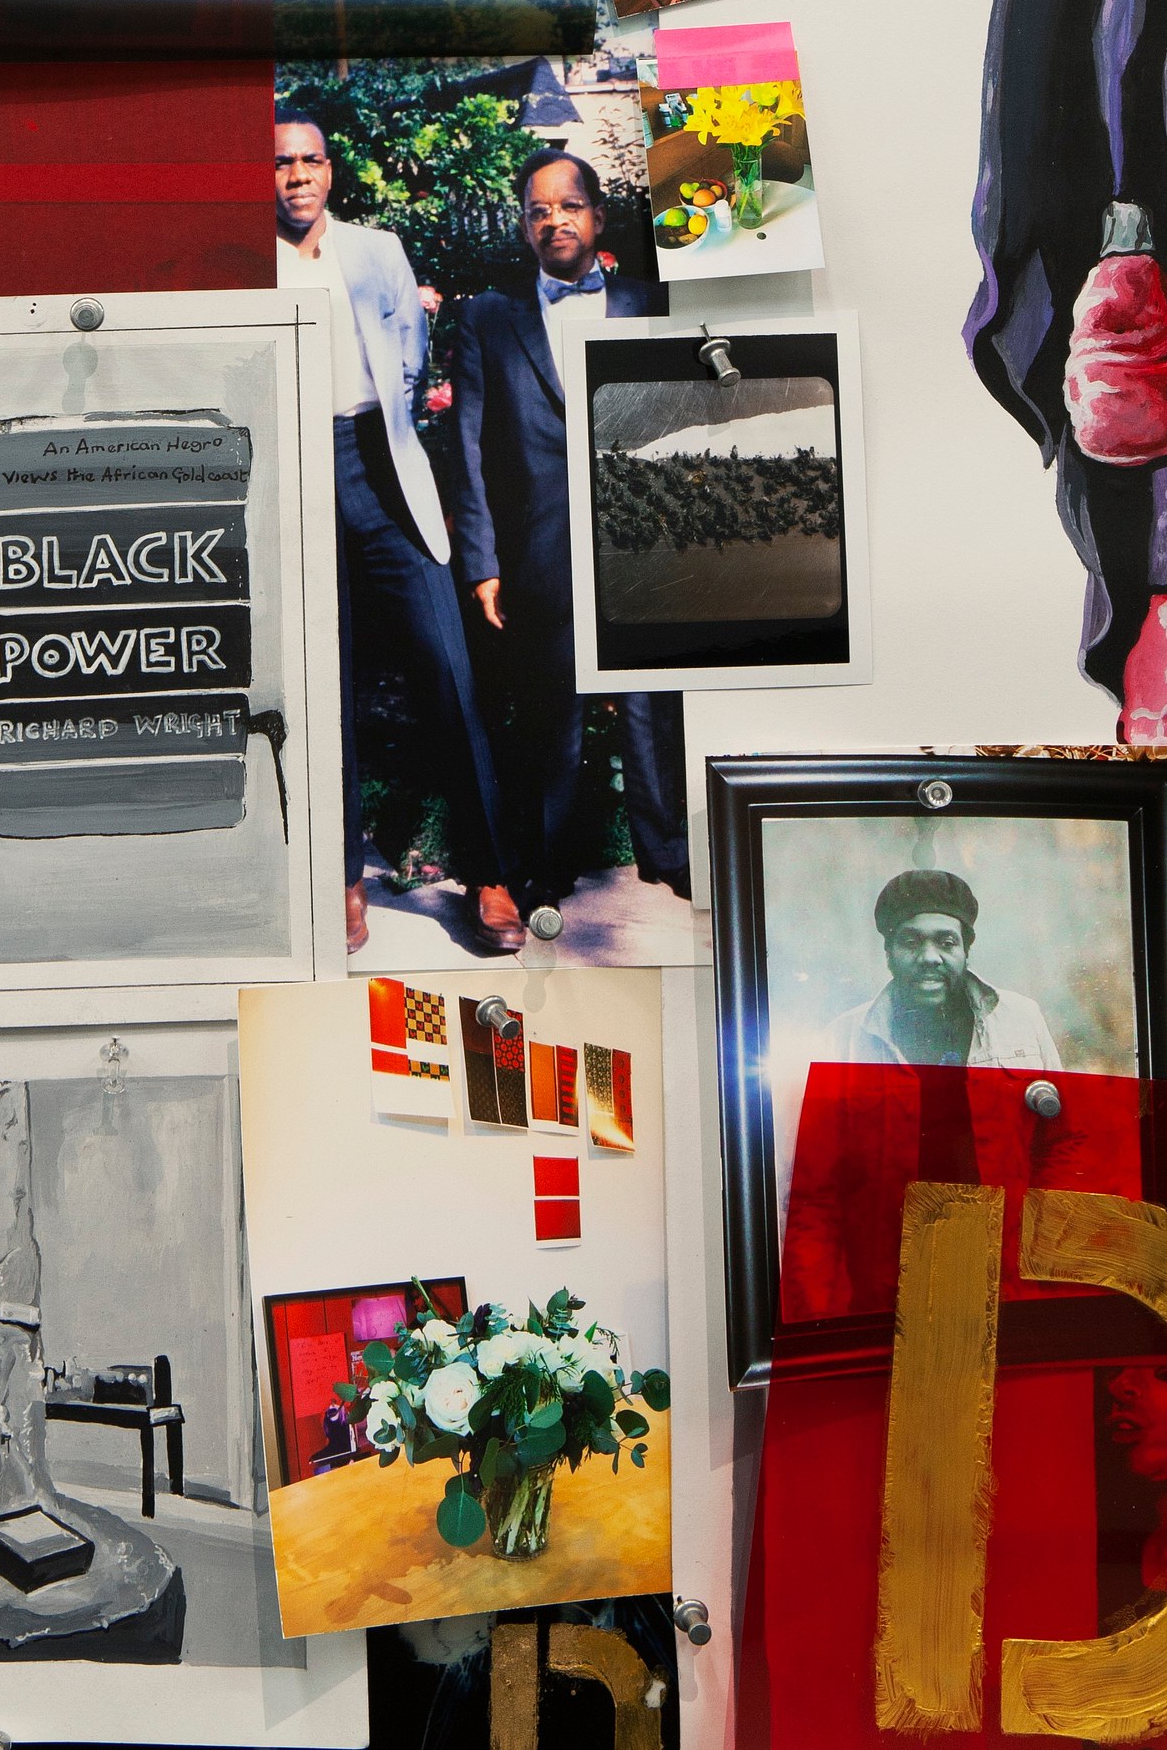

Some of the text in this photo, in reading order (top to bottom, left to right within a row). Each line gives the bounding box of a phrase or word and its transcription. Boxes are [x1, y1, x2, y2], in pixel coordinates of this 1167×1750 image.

[43, 441, 70, 457] An
[75, 437, 161, 455] American
[67, 468, 96, 484] the
[100, 466, 168, 484] African
[134, 709, 240, 738] WRIGHT
